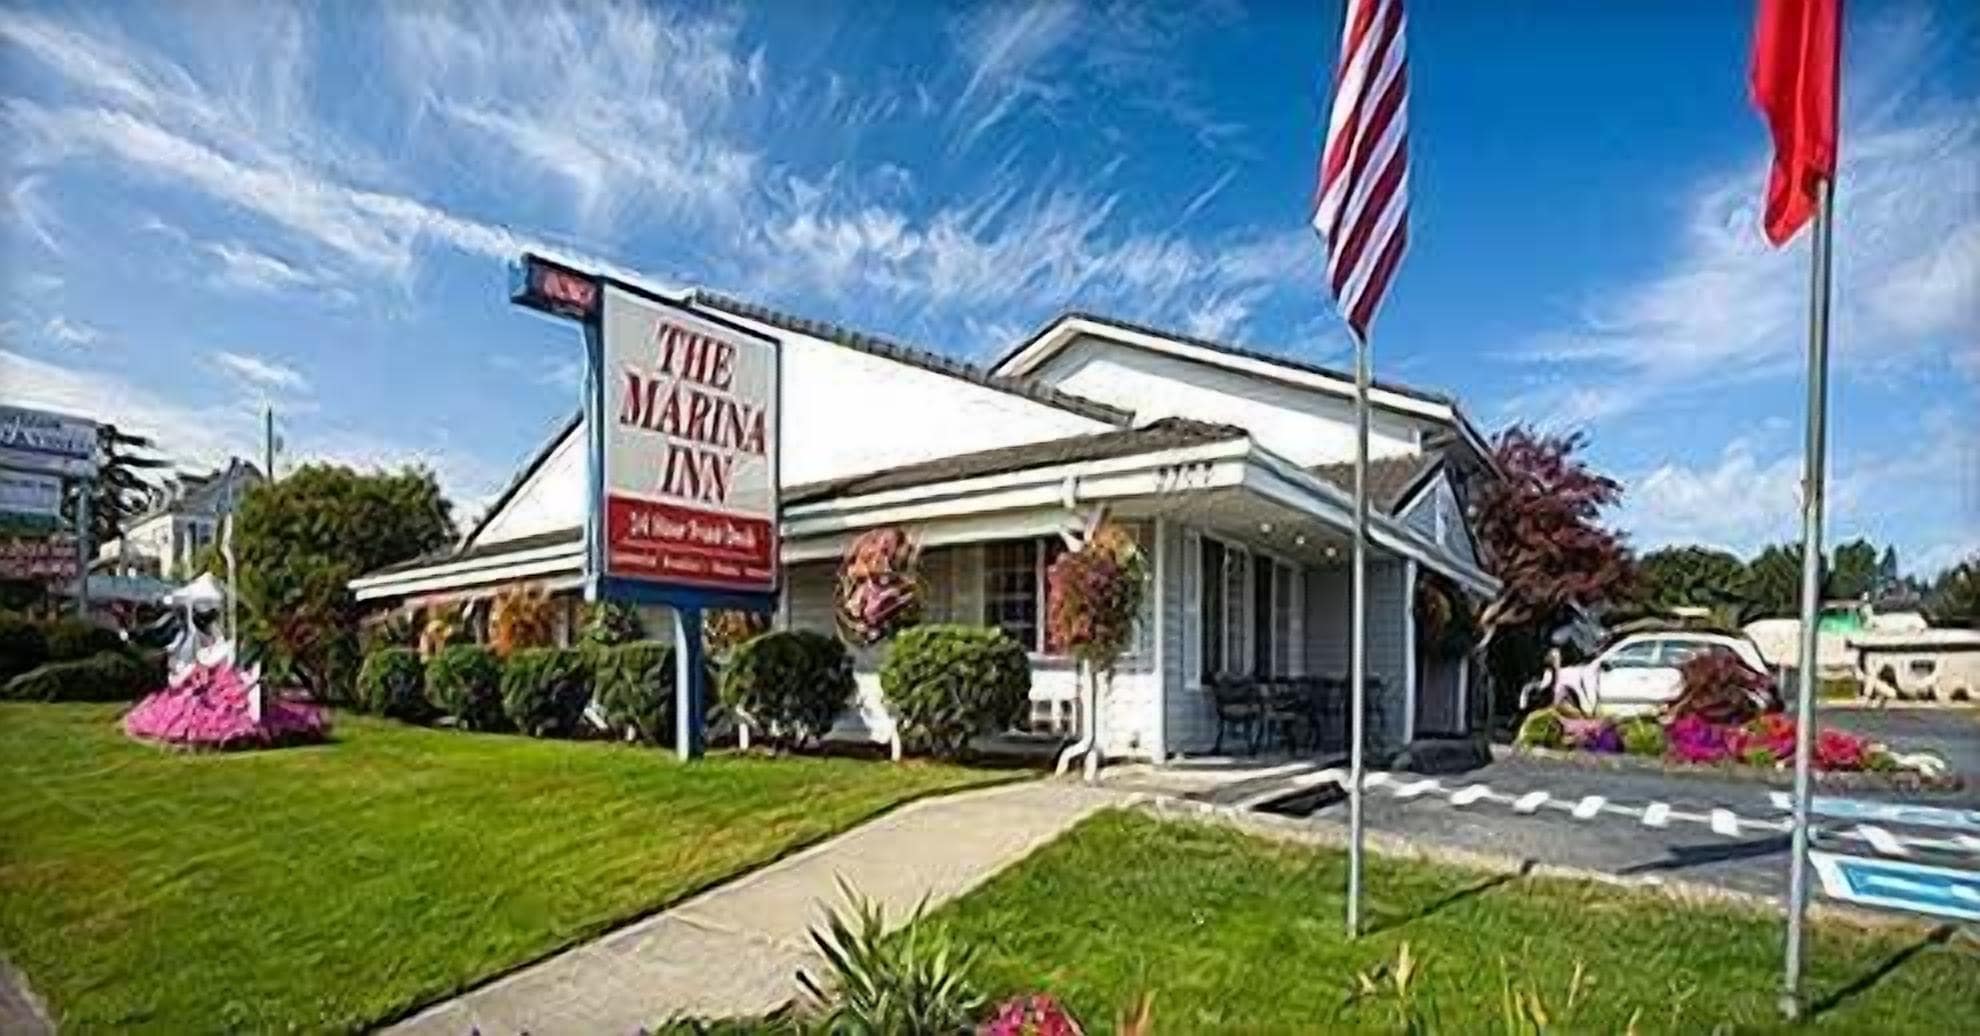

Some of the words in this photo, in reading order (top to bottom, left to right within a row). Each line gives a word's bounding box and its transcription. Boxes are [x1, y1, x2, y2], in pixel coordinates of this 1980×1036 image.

[657, 321, 738, 391] THE
[619, 371, 766, 455] MARINA
[661, 443, 733, 504] INN
